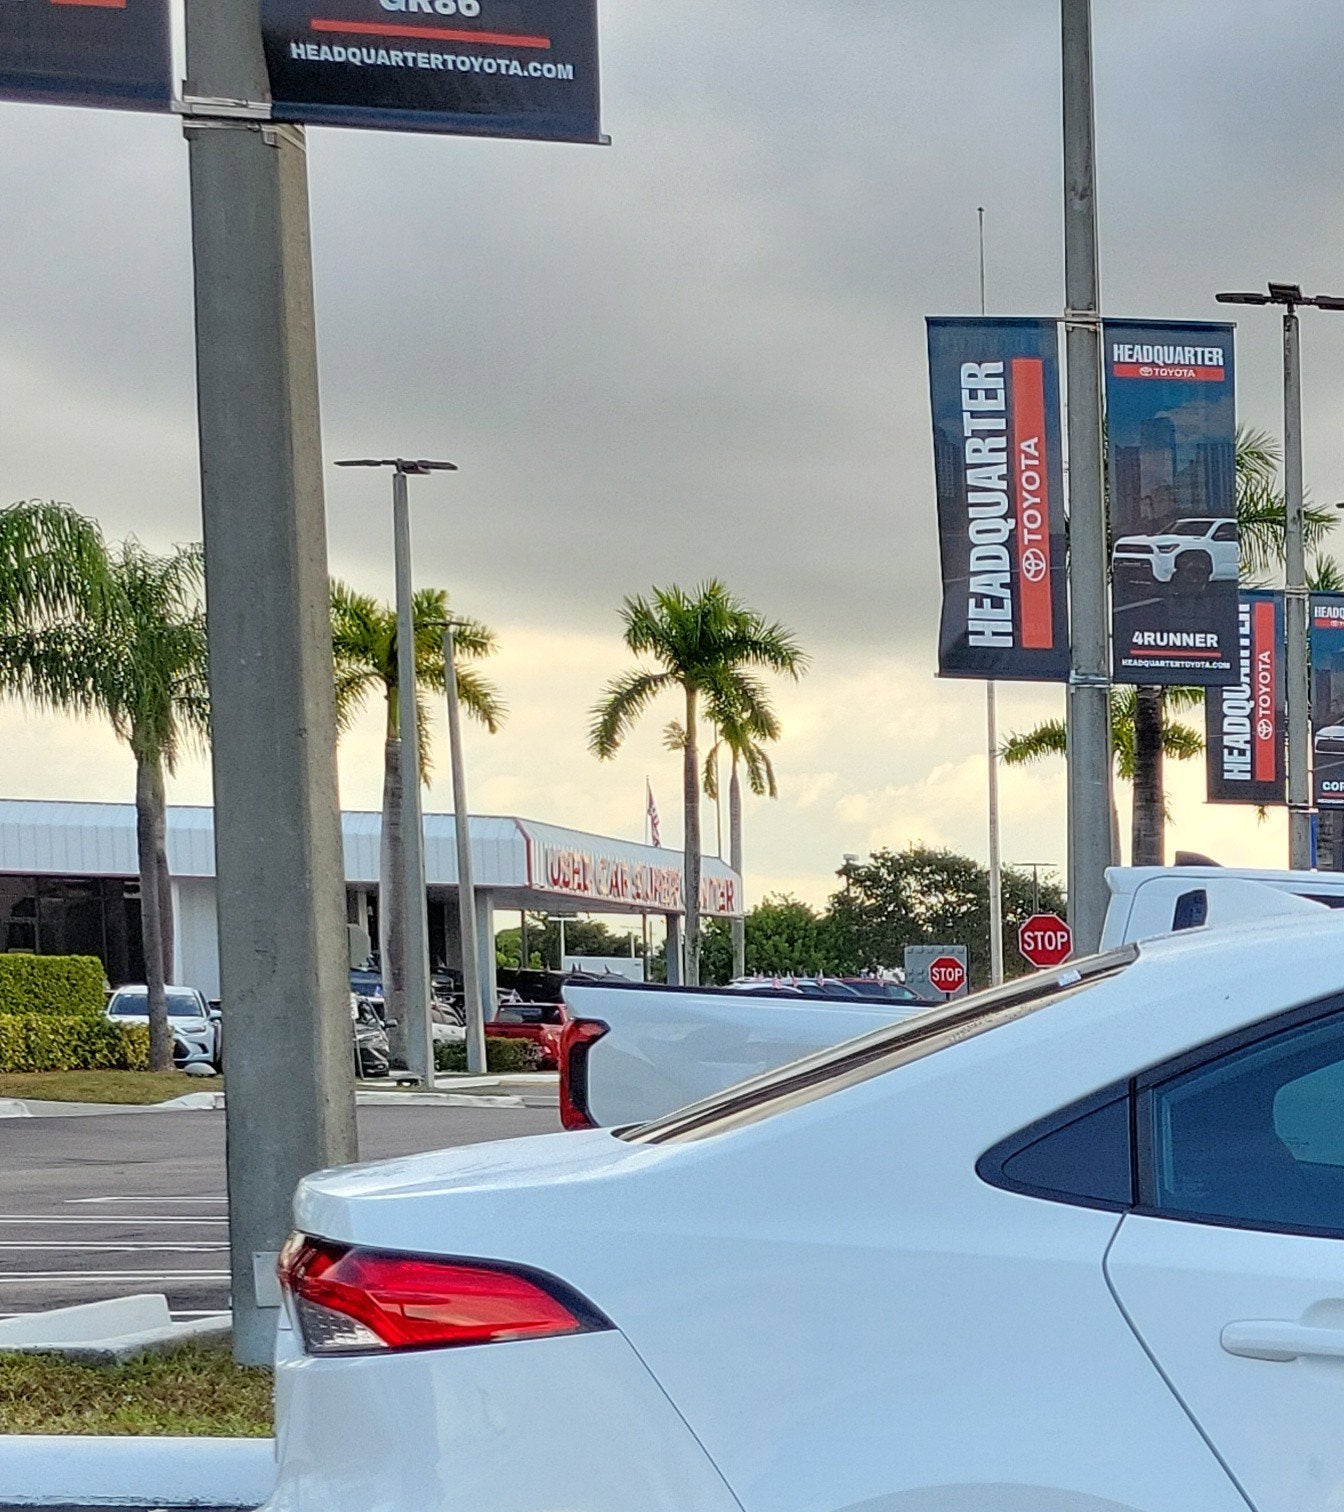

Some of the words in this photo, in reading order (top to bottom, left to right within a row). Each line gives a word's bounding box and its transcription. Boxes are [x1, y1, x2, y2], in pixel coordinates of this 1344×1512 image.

[290, 42, 575, 80] HEADQUARTERTOYOTA.COM
[1113, 344, 1224, 366] HEADQUARTER
[1153, 367, 1196, 378] TOYOTA
[1020, 436, 1043, 545] TOYOTA
[960, 361, 1016, 648] HEADQUARTER
[1132, 631, 1219, 648] 4RUNNER
[1121, 658, 1231, 670] HEADQUARTERTOYOTA.COM
[1258, 650, 1272, 717] TOYOTA
[1023, 931, 1068, 951] STOP
[931, 967, 963, 982] STOP
